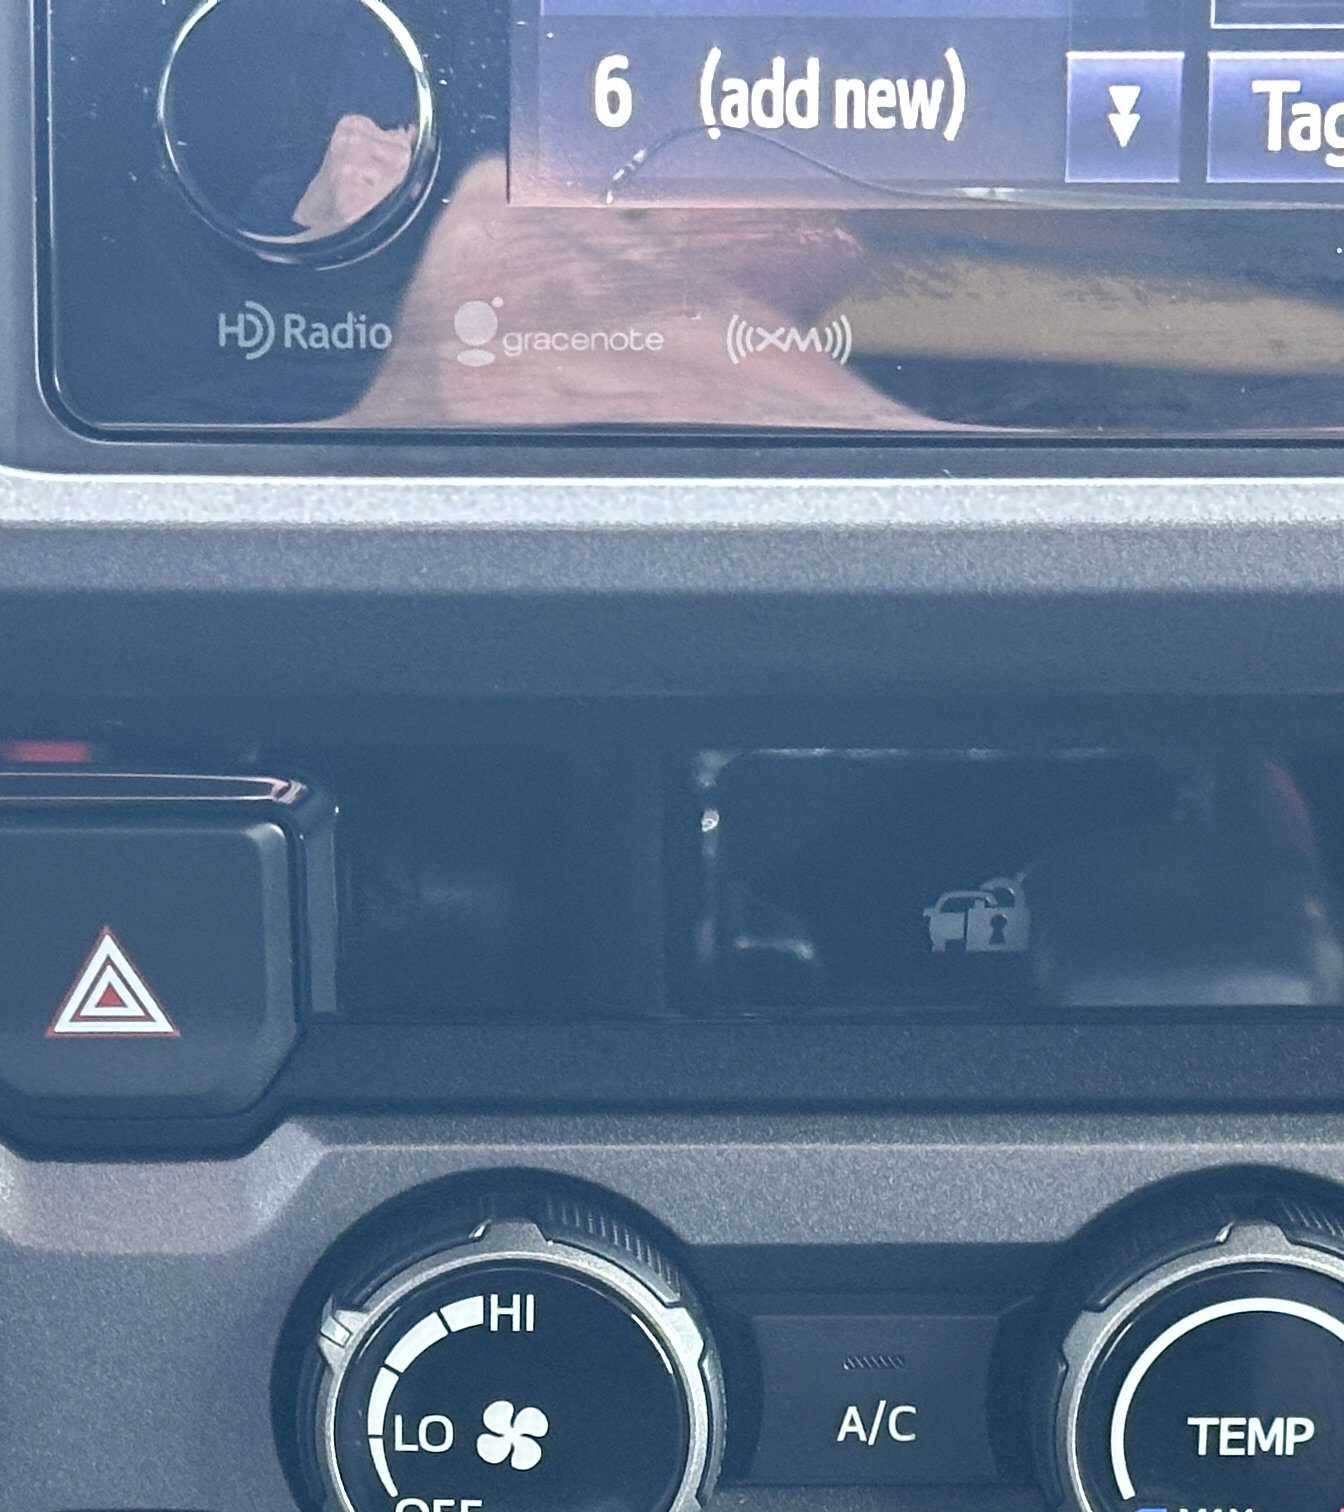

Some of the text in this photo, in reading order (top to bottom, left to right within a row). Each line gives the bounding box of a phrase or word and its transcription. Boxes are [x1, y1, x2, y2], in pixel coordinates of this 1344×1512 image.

[594, 45, 966, 142] 6 (add new)
[284, 313, 392, 350] Radio
[502, 326, 665, 358] gracenote
[490, 1293, 535, 1332] HI
[394, 1414, 454, 1453] LO
[836, 1399, 917, 1446] A/C
[1187, 1416, 1315, 1456] TEMP
